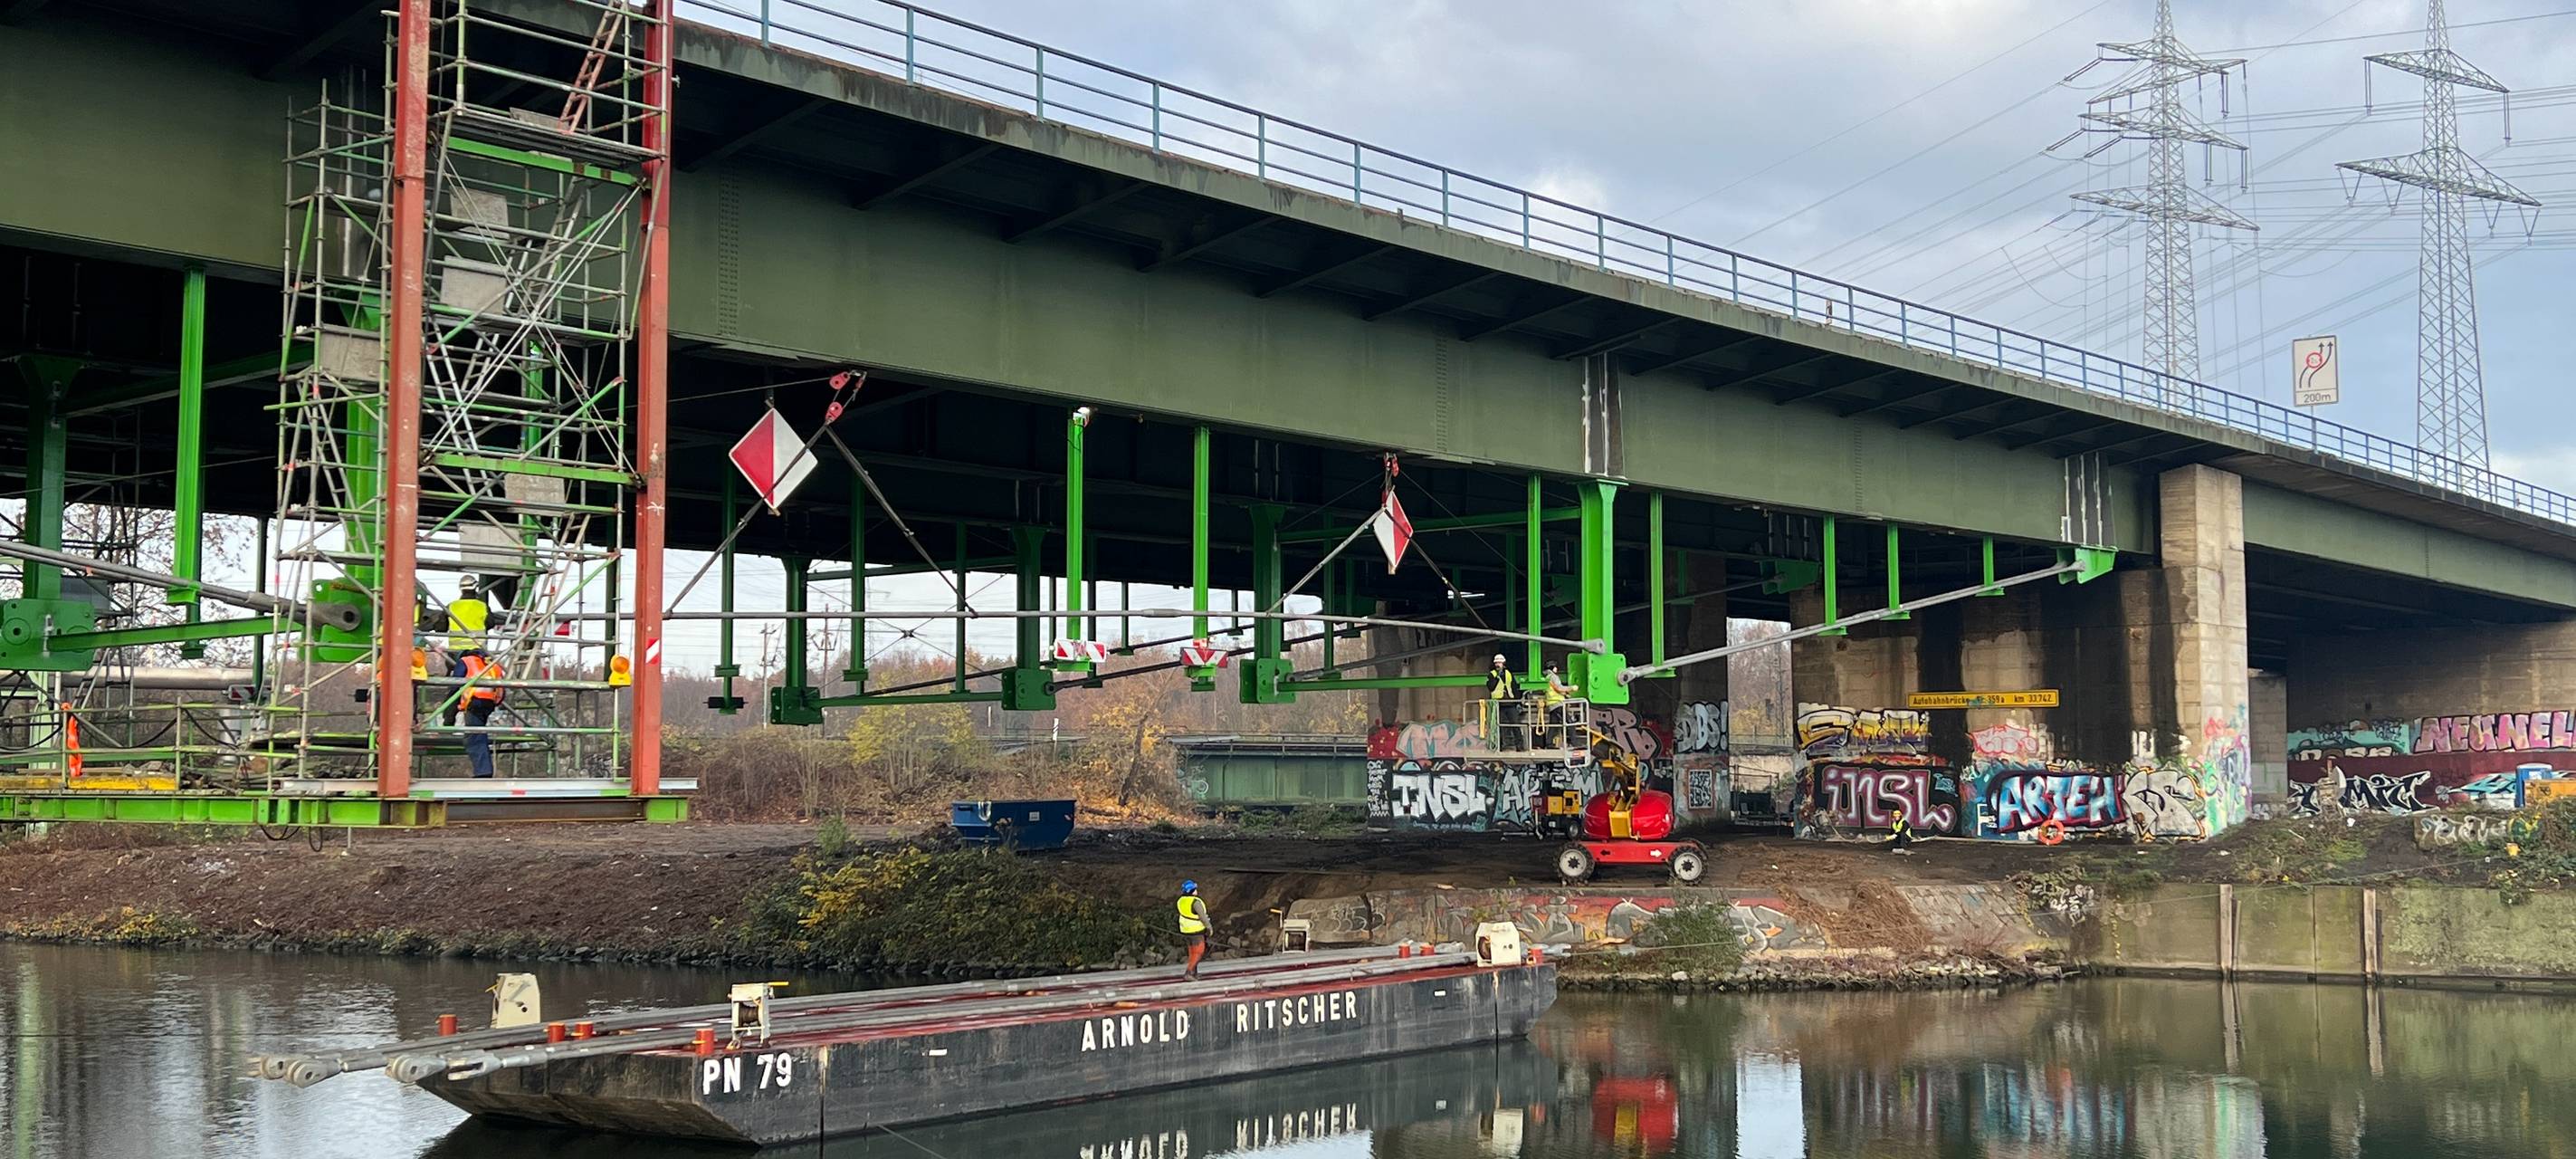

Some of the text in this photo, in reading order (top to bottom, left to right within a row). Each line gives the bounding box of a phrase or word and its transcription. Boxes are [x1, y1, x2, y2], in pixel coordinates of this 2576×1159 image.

[2304, 393, 2332, 403] 200m
[2014, 694, 2025, 703] km
[2413, 711, 2576, 753] NEUNEL
[1081, 991, 1358, 1051] ARNOLD RITSCHER
[702, 1052, 792, 1095] PN 79
